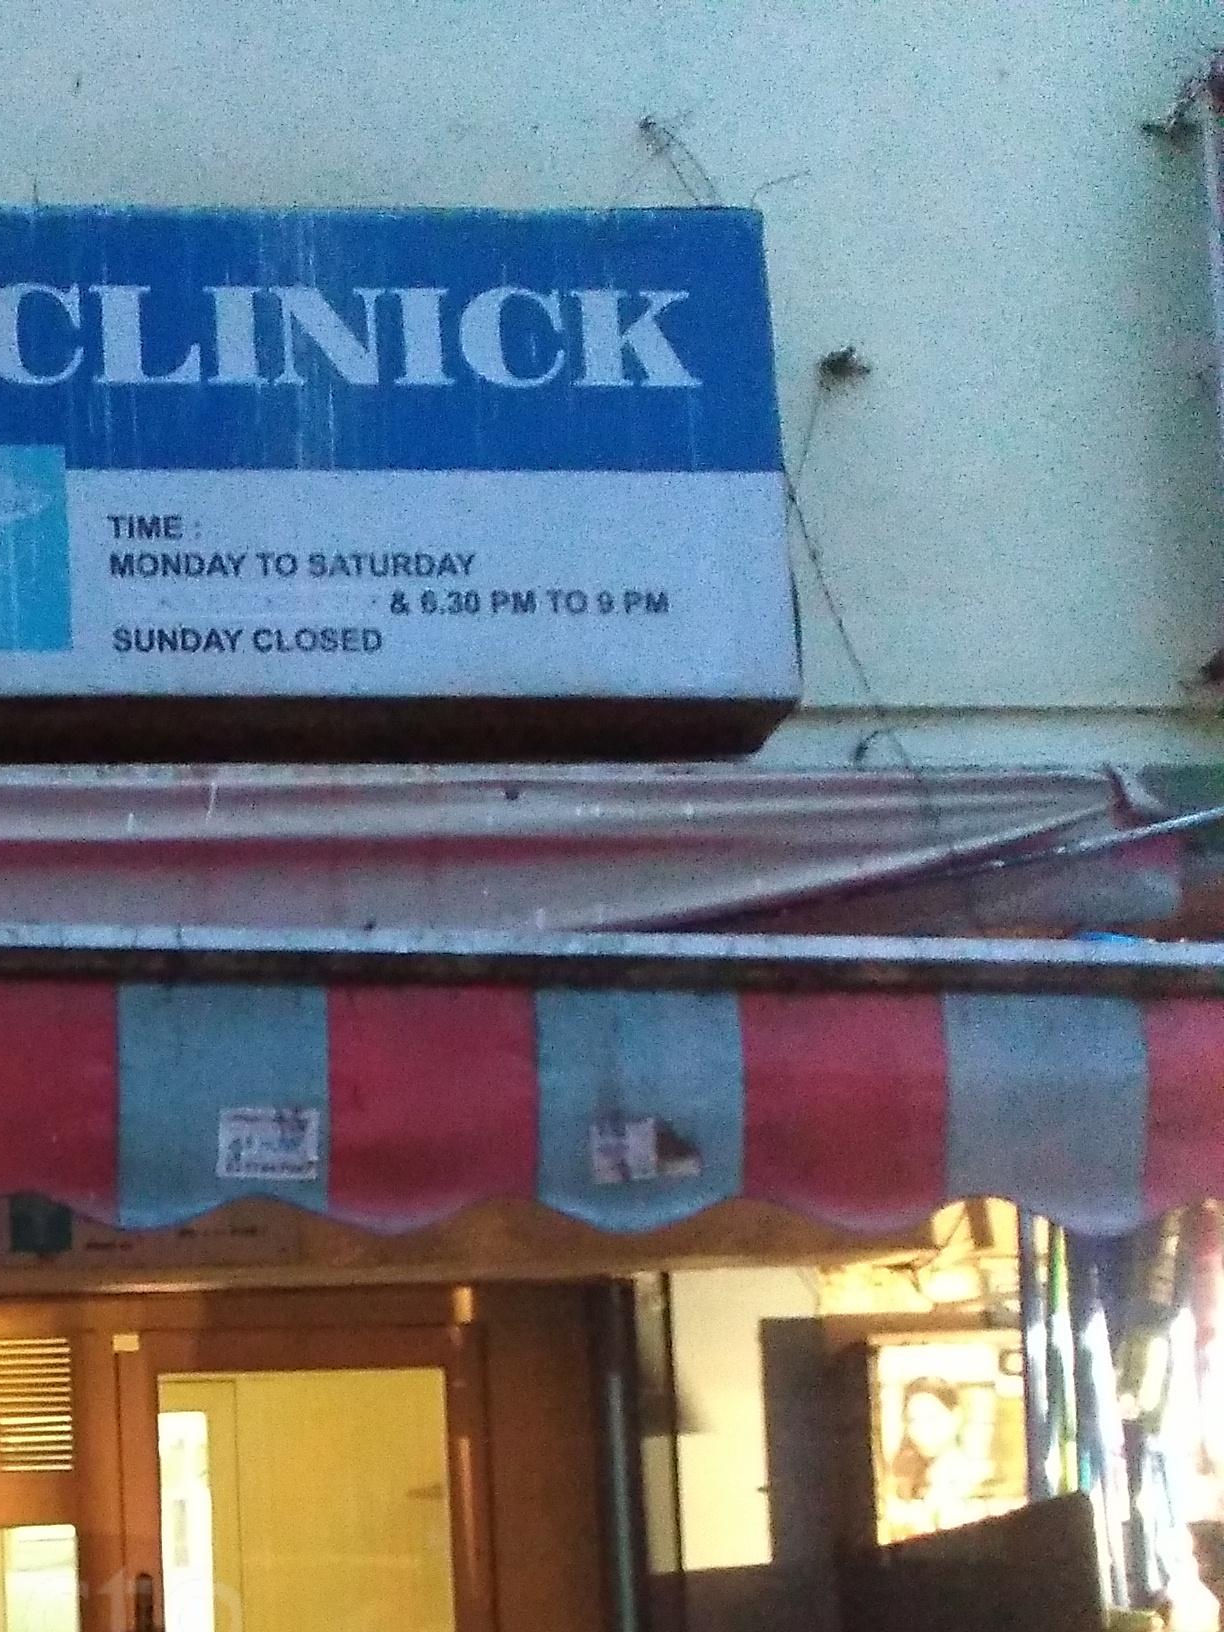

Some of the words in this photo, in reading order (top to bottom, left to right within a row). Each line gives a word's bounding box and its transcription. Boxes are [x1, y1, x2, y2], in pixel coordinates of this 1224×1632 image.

[109, 552, 245, 578] MONDAY
[256, 552, 298, 577] TO
[307, 552, 475, 577] SATURDAY
[390, 590, 409, 616] &
[420, 589, 480, 615] 6.30
[490, 589, 537, 615] PM
[546, 589, 587, 614] TO
[624, 590, 669, 614] PM
[112, 627, 244, 652] SUNDAY
[252, 627, 382, 652] CLOSED
